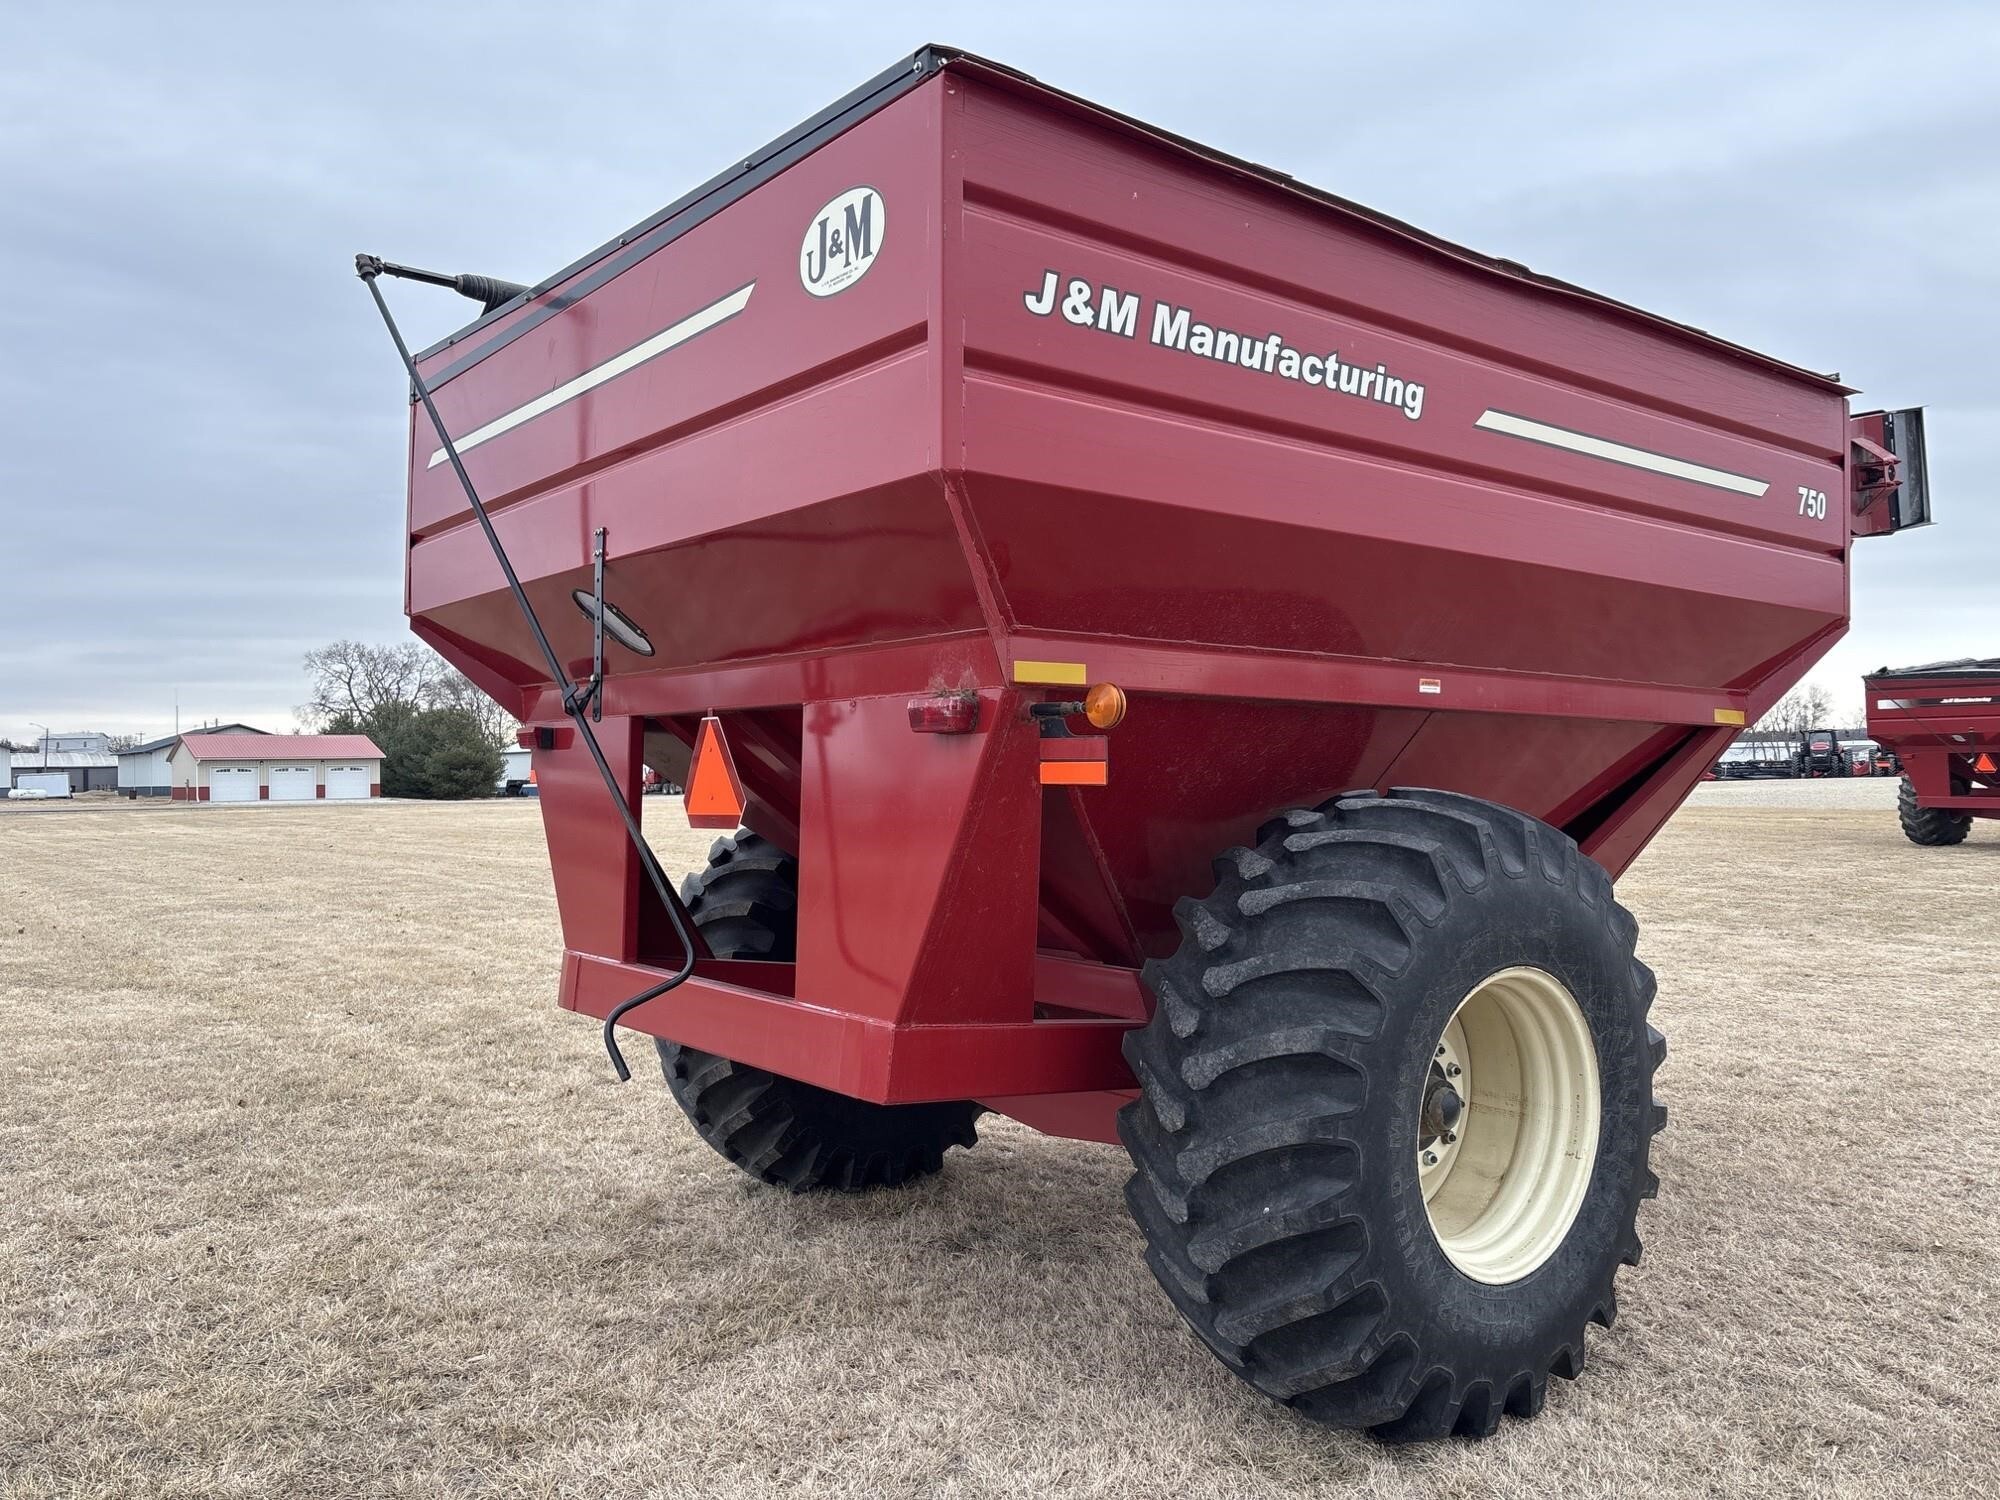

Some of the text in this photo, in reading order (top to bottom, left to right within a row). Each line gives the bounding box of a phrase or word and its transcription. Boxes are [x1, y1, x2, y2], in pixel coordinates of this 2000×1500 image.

[806, 192, 874, 284] J&M
[1023, 271, 1426, 420] J&M Manufacturing
[1797, 485, 1827, 521] 750
